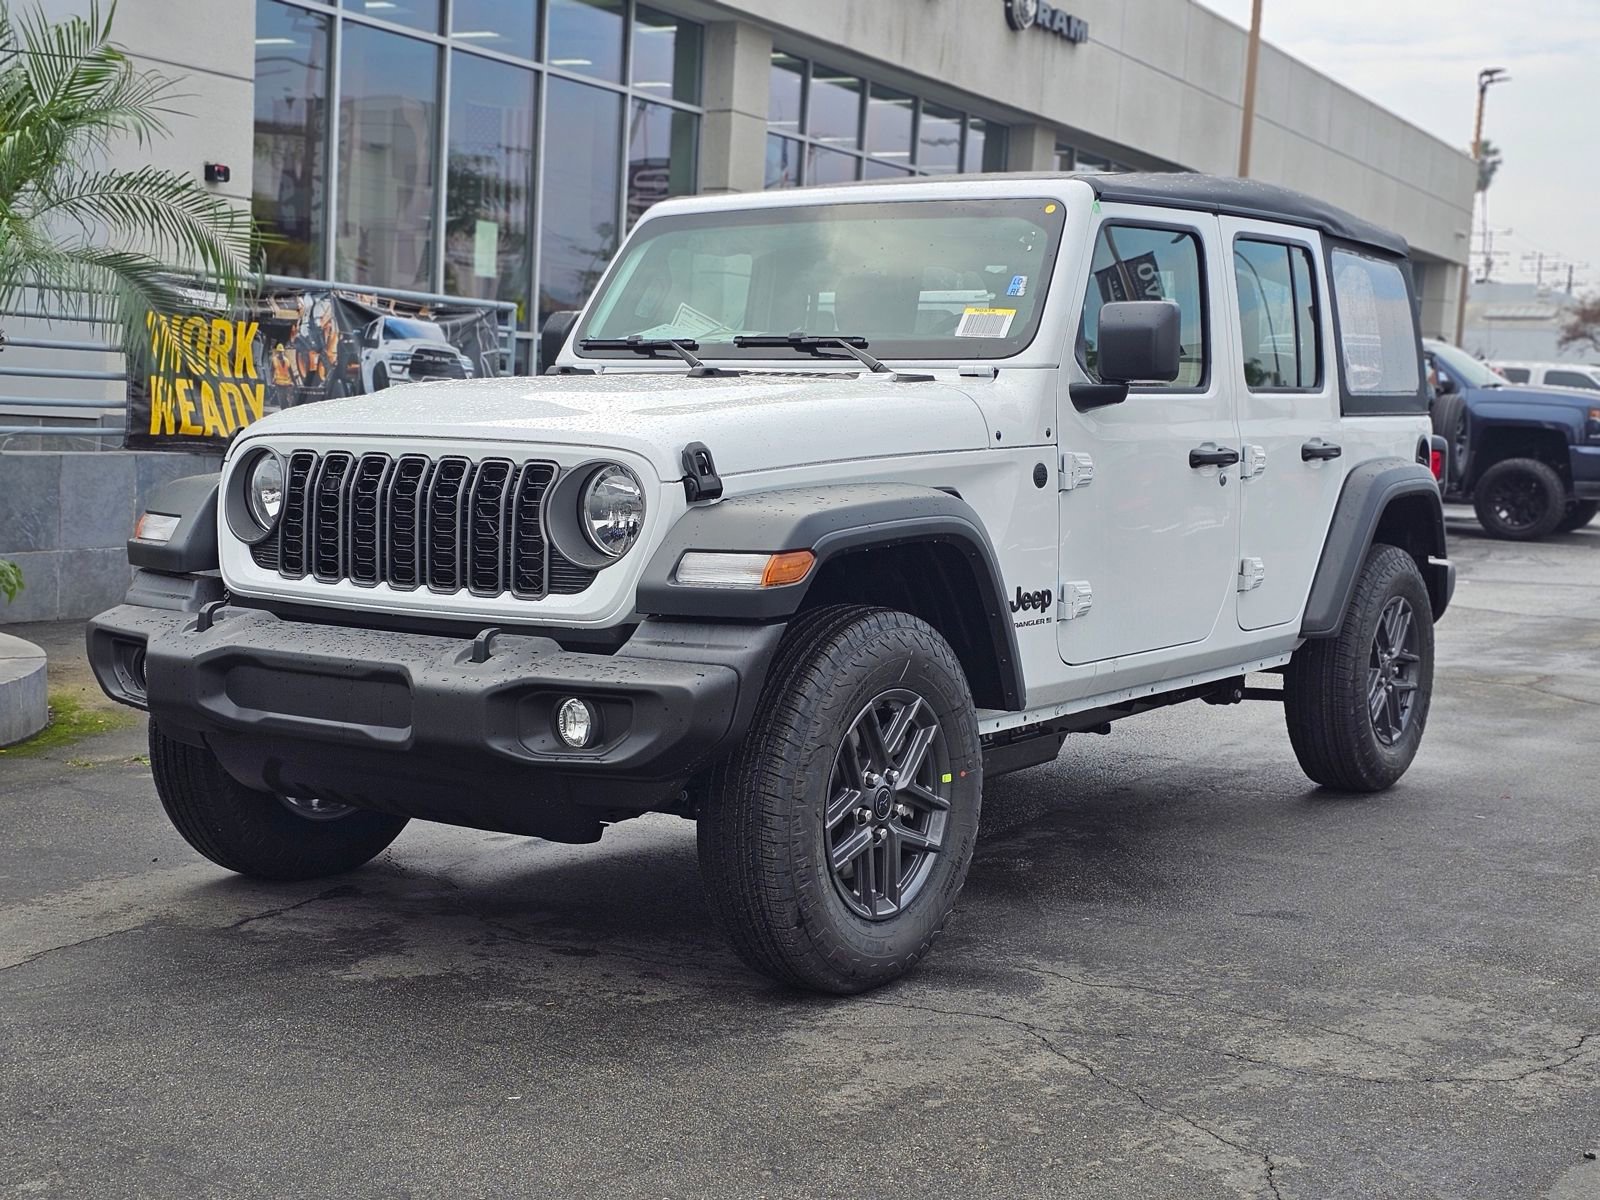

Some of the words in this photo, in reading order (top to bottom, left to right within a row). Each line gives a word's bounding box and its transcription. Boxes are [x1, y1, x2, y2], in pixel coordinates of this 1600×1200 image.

[1036, 1, 1088, 43] RAM
[147, 310, 259, 379] WORK
[150, 375, 265, 437] READY
[1009, 586, 1052, 613] Jeep
[1014, 618, 1045, 628] RANGLER
